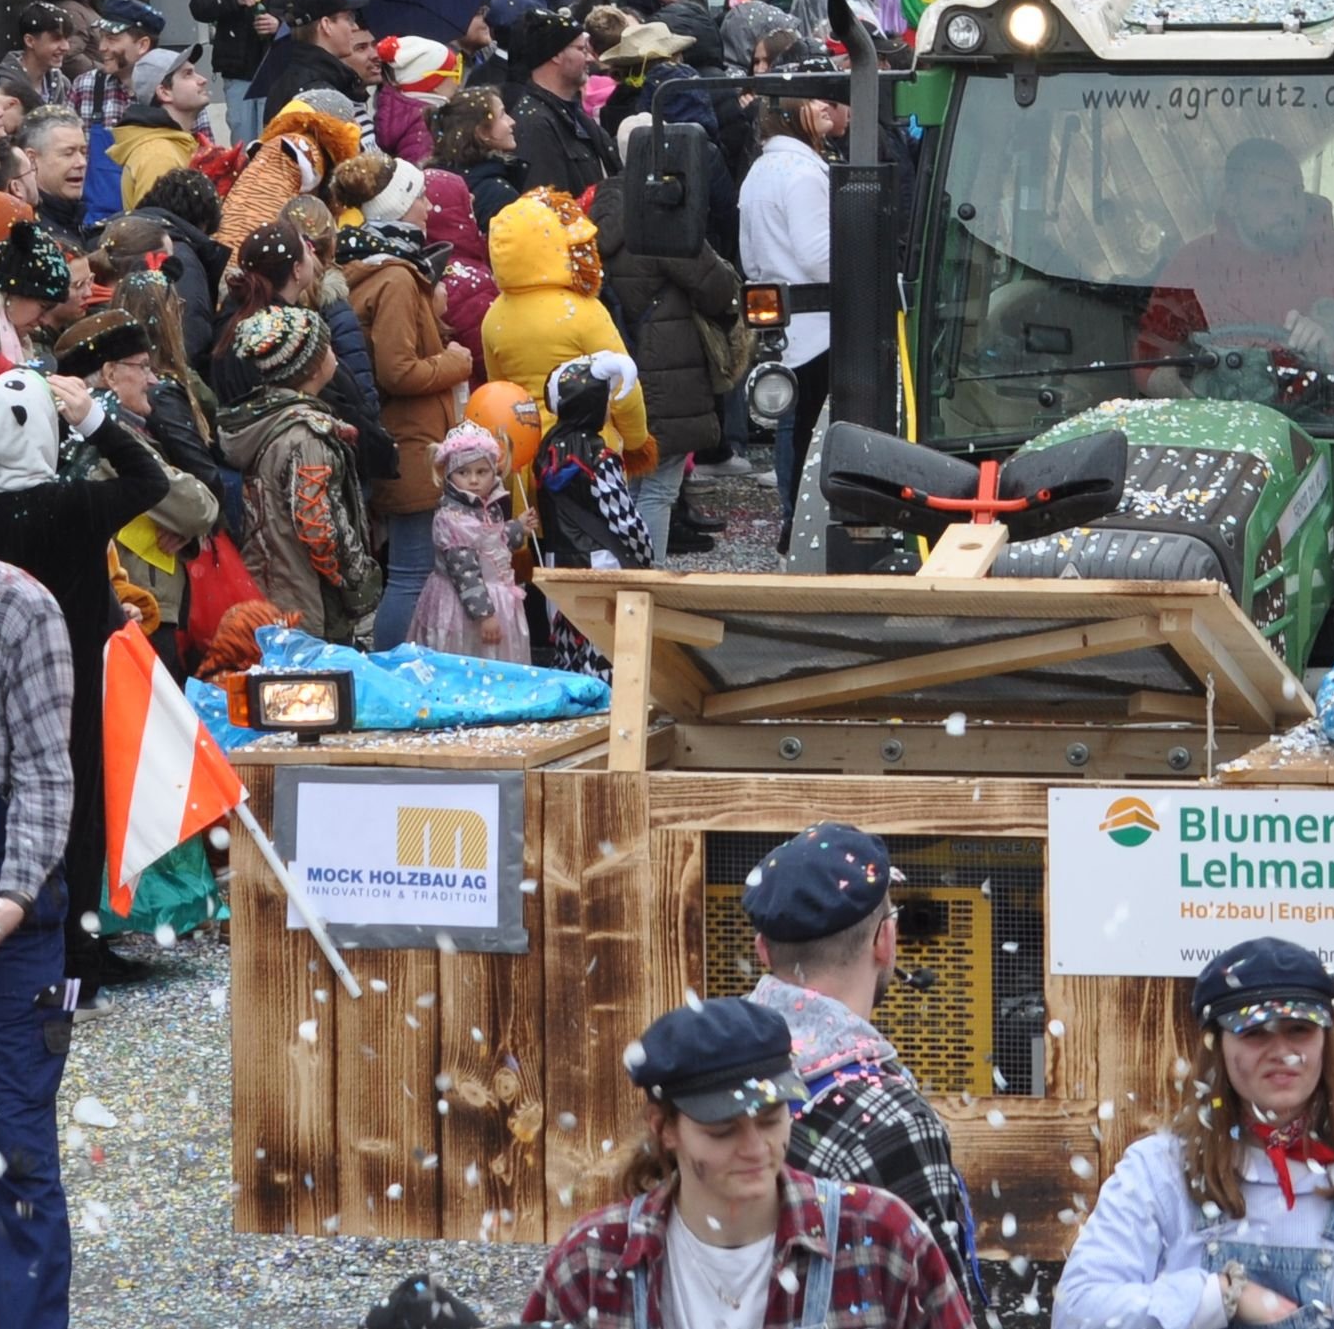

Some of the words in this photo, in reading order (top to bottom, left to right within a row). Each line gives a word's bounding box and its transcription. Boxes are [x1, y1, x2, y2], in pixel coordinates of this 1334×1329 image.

[307, 867, 364, 885] MOCK
[369, 871, 457, 889] HOLZBAU
[461, 875, 488, 890] AG
[306, 886, 392, 899] INNOVATION
[397, 890, 406, 899] &
[412, 891, 488, 904] TRADITION
